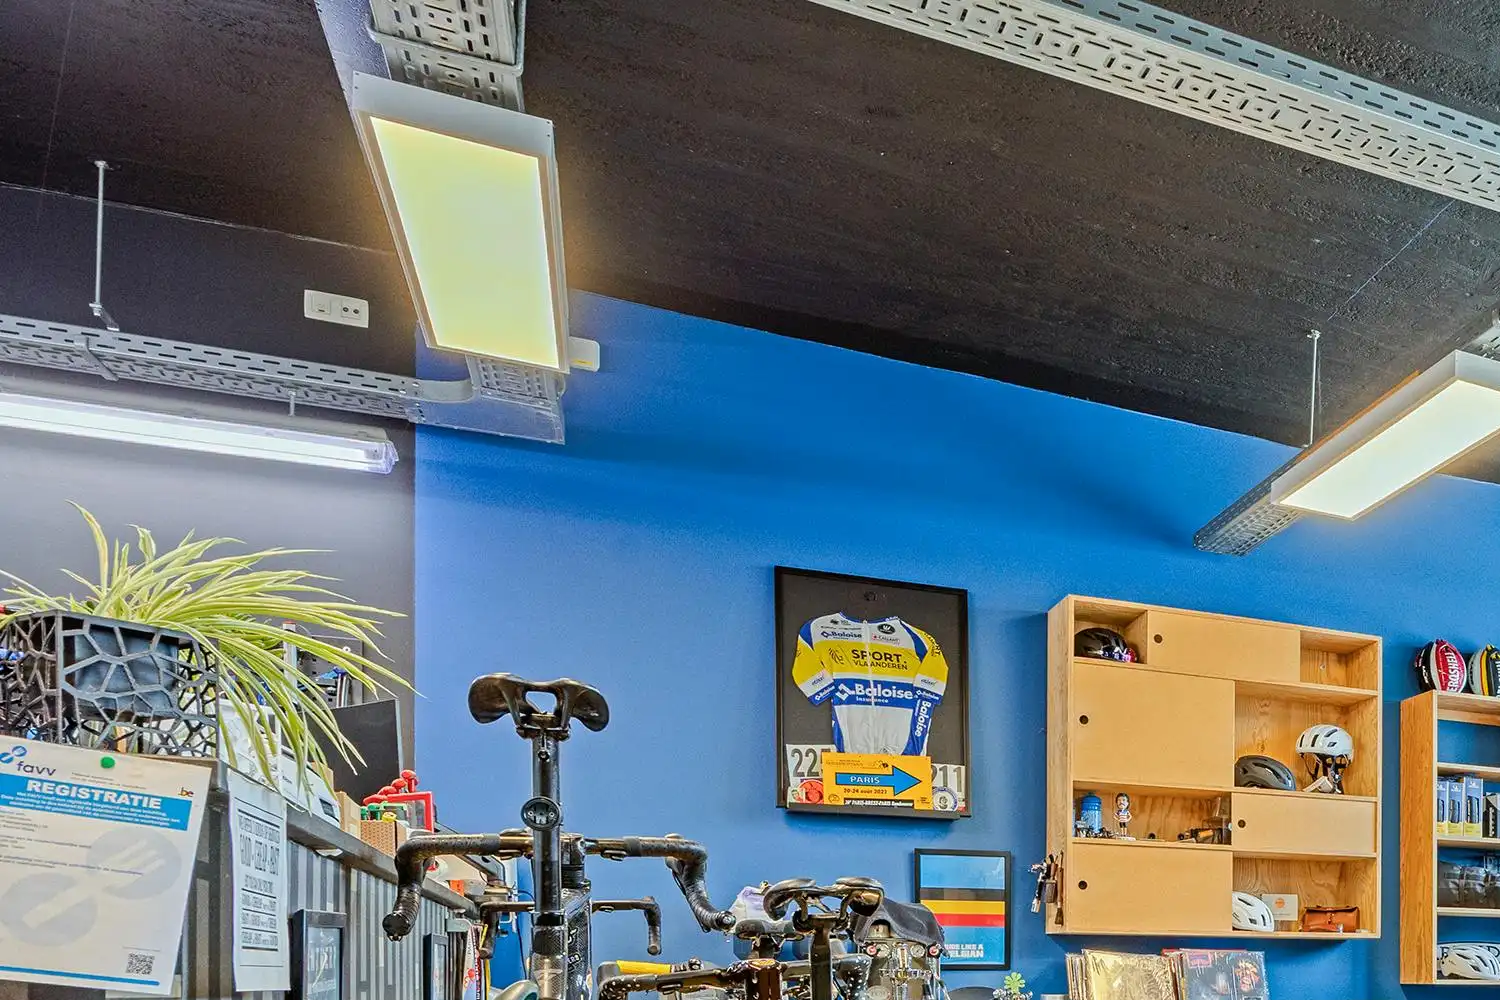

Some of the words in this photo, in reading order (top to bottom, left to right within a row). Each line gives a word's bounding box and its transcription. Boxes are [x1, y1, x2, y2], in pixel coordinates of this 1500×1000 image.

[854, 683, 913, 700] Baloise
[914, 701, 932, 737] Baloise
[16, 760, 56, 777] favv
[849, 775, 881, 784] PARIS
[26, 779, 162, 809] REGISTRATIE
[949, 950, 984, 958] ELGIAN
